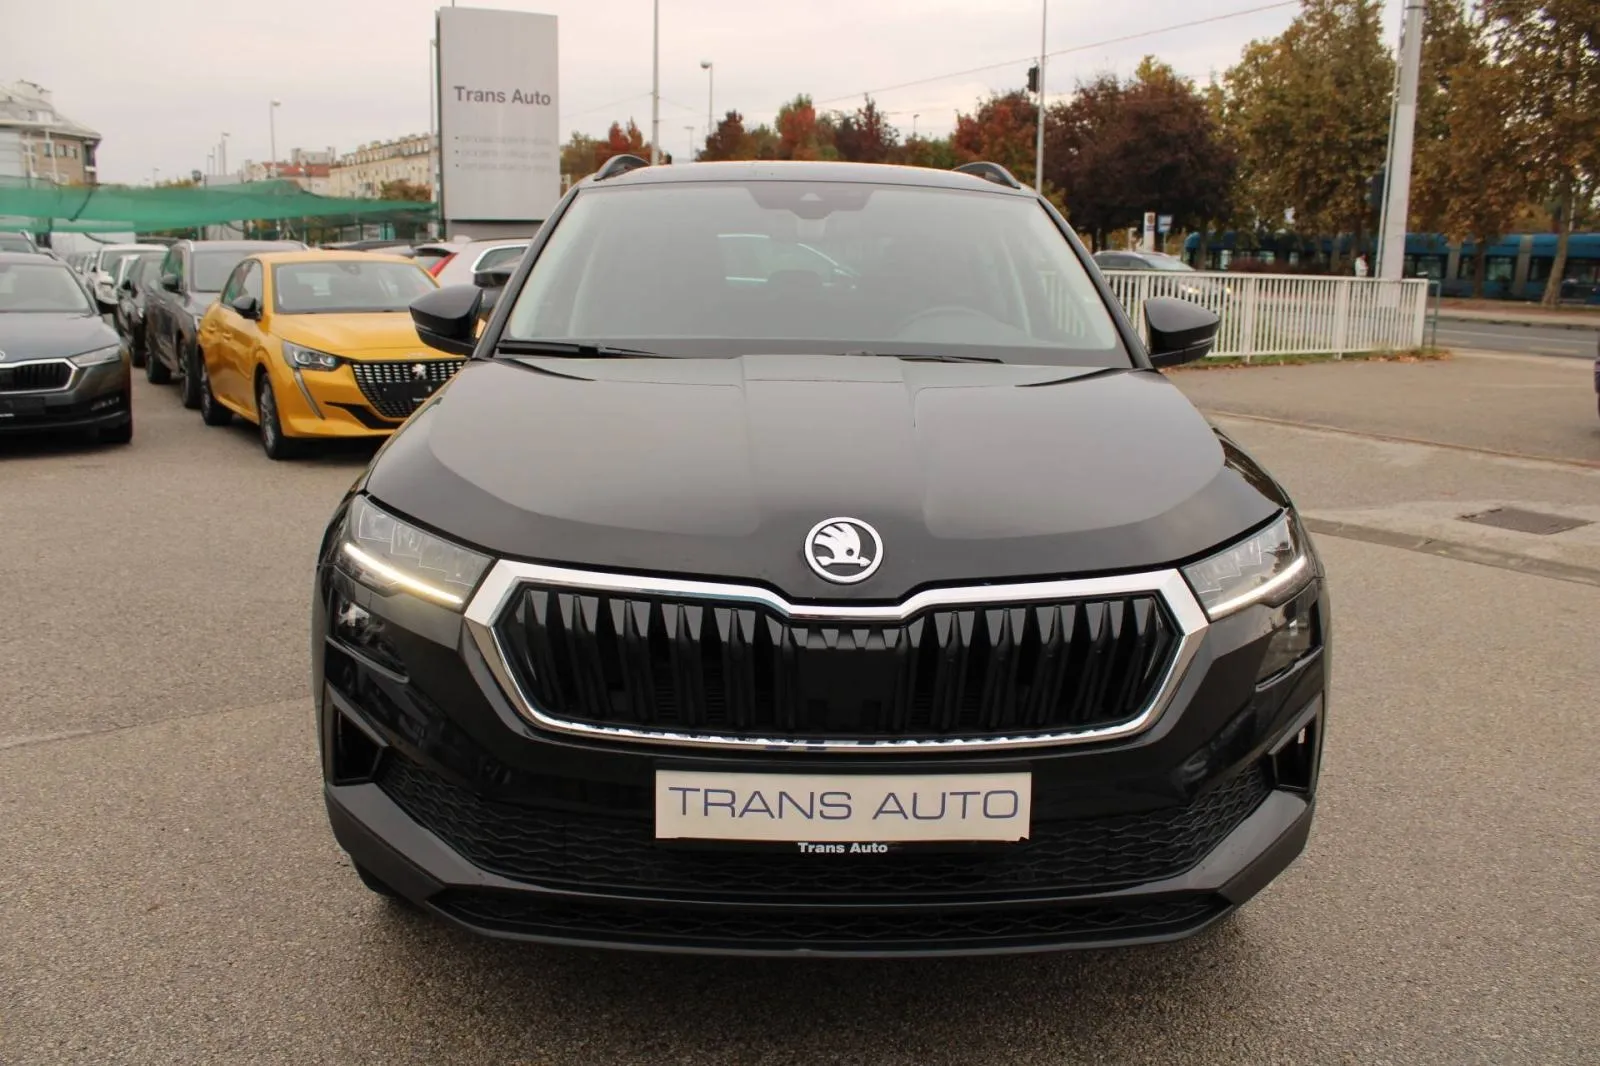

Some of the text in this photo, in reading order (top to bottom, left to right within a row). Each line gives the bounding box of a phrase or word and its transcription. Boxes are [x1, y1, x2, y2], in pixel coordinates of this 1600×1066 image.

[453, 85, 551, 106] Trans Auto
[668, 787, 1018, 820] TRANS AUTO
[798, 842, 888, 853] Trans Auto
